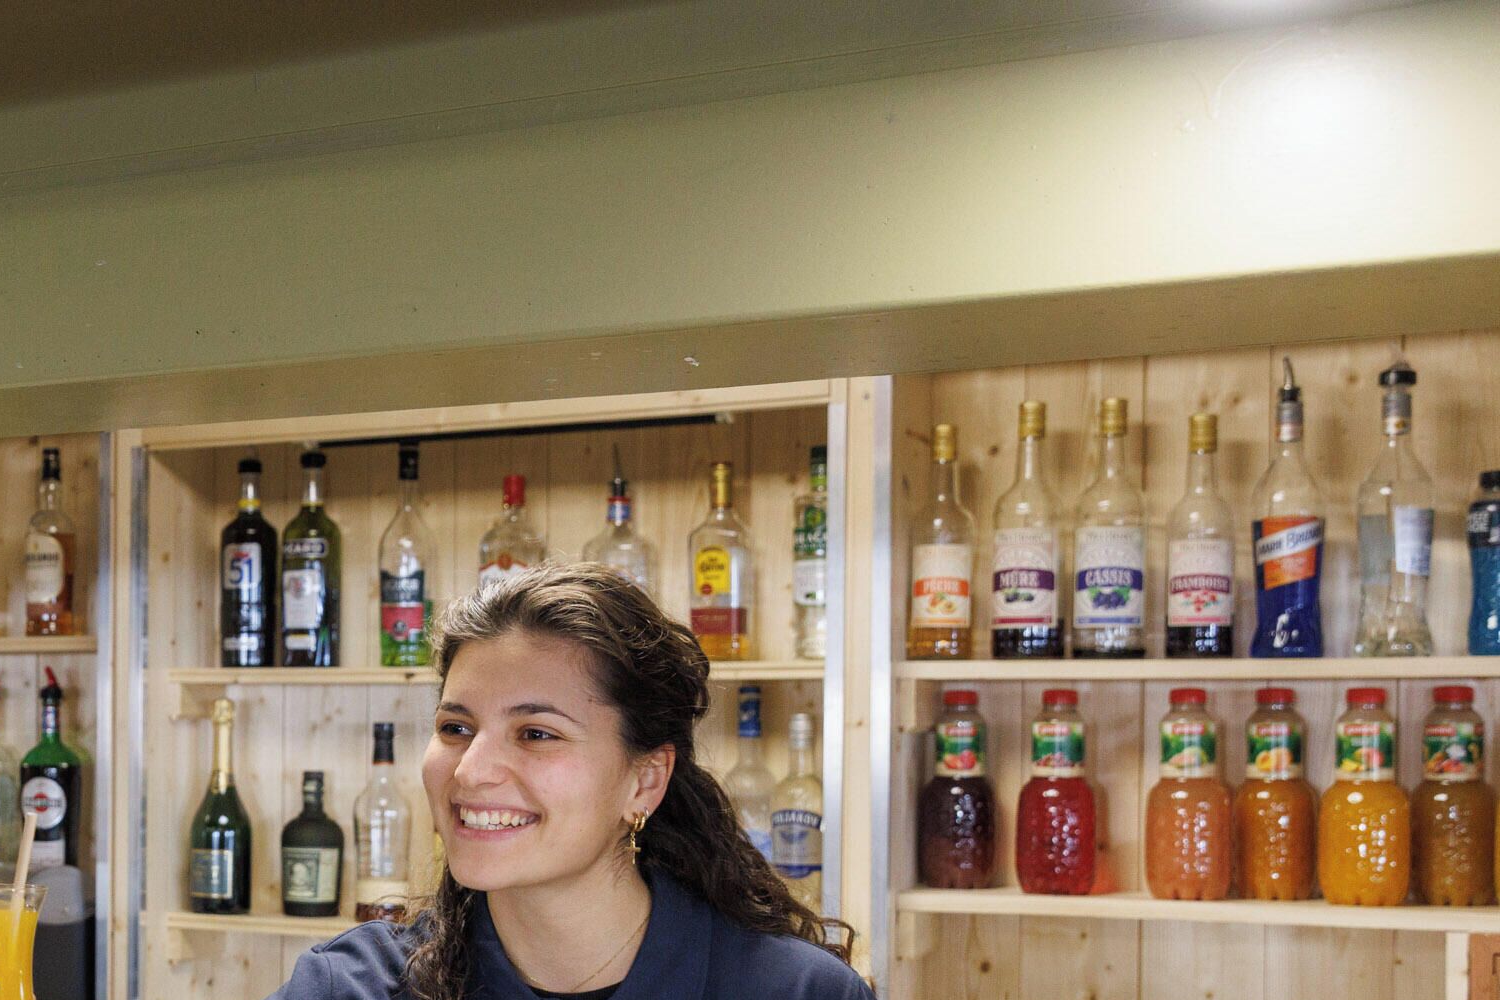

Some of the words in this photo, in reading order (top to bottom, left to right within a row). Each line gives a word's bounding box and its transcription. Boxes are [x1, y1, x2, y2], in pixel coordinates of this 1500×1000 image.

[228, 557, 253, 584] 51
[1085, 568, 1134, 587] CASSIS
[1171, 575, 1230, 593] FRAMBOISE
